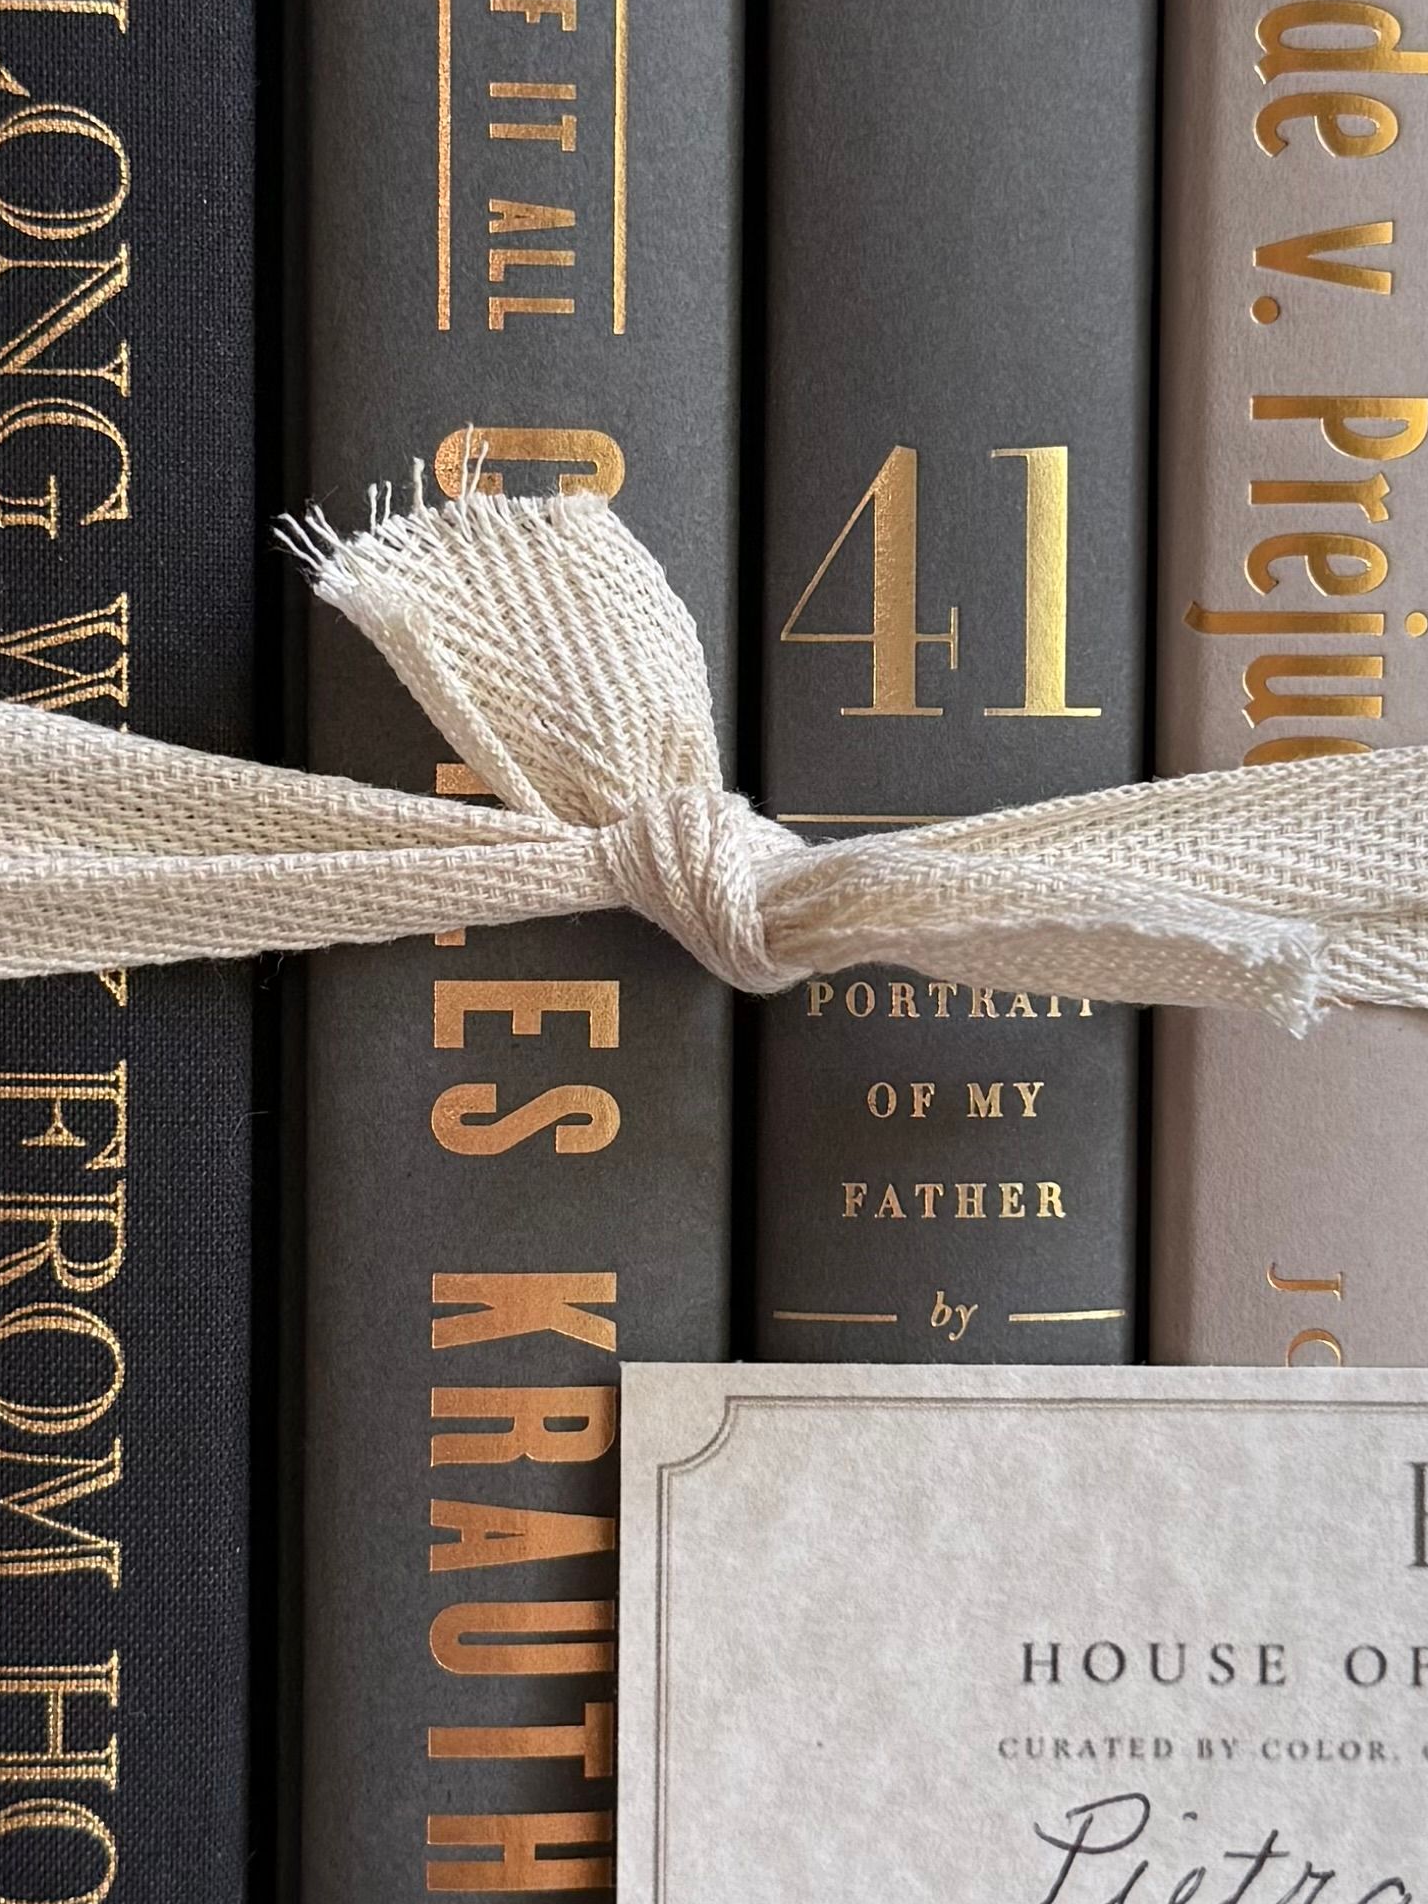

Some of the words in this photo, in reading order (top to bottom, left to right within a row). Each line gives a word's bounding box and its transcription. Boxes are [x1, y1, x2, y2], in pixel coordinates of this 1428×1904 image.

[488, 83, 576, 151] IT
[488, 200, 574, 330] ALL
[1253, 223, 1392, 323] v.
[781, 446, 1101, 717] 41
[868, 1083, 935, 1117] OF
[968, 1082, 1044, 1117] MY
[842, 1182, 1067, 1218] FATHER
[931, 1292, 978, 1341] by
[1022, 1641, 1287, 1689] HOUSE
[997, 1736, 1174, 1760] CURATED
[1198, 1739, 1237, 1759] BY
